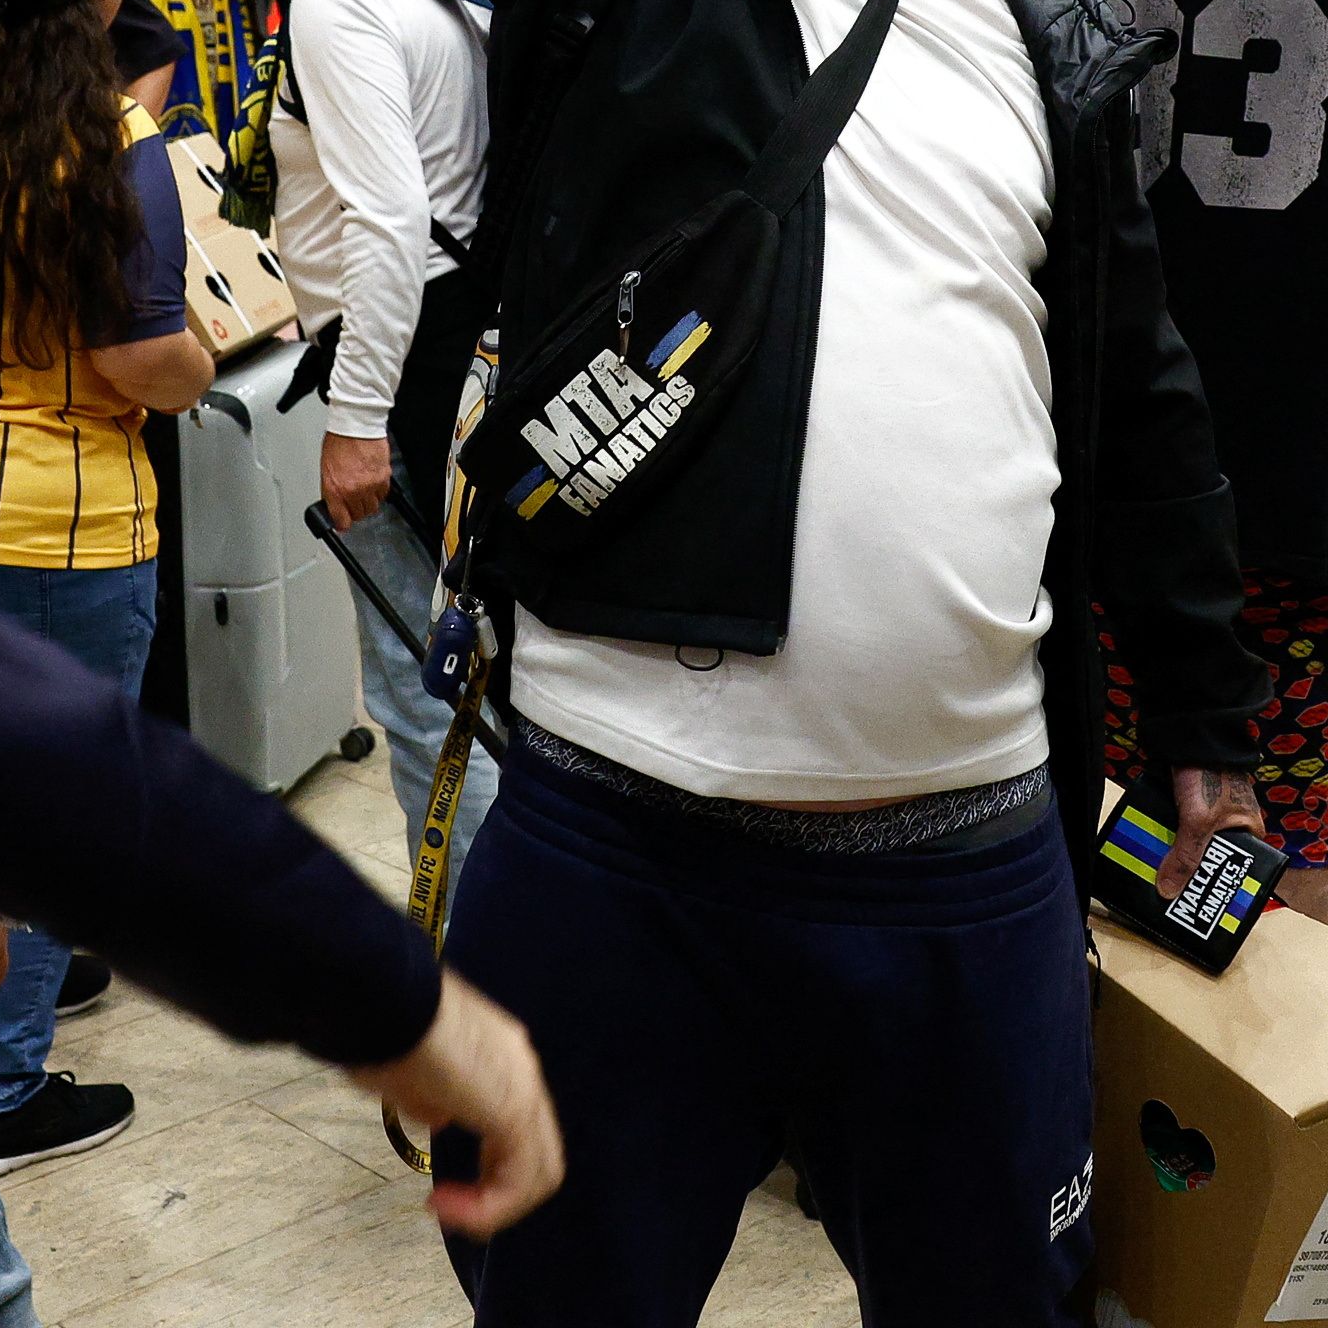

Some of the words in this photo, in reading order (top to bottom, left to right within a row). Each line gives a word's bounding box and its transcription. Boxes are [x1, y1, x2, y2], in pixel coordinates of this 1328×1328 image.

[520, 348, 655, 480] MTA
[558, 374, 696, 517] FANATICS
[414, 872, 432, 904] AVIV
[420, 855, 437, 874] FC
[1173, 840, 1234, 924] MACCABI
[1198, 860, 1241, 923] FANATICS
